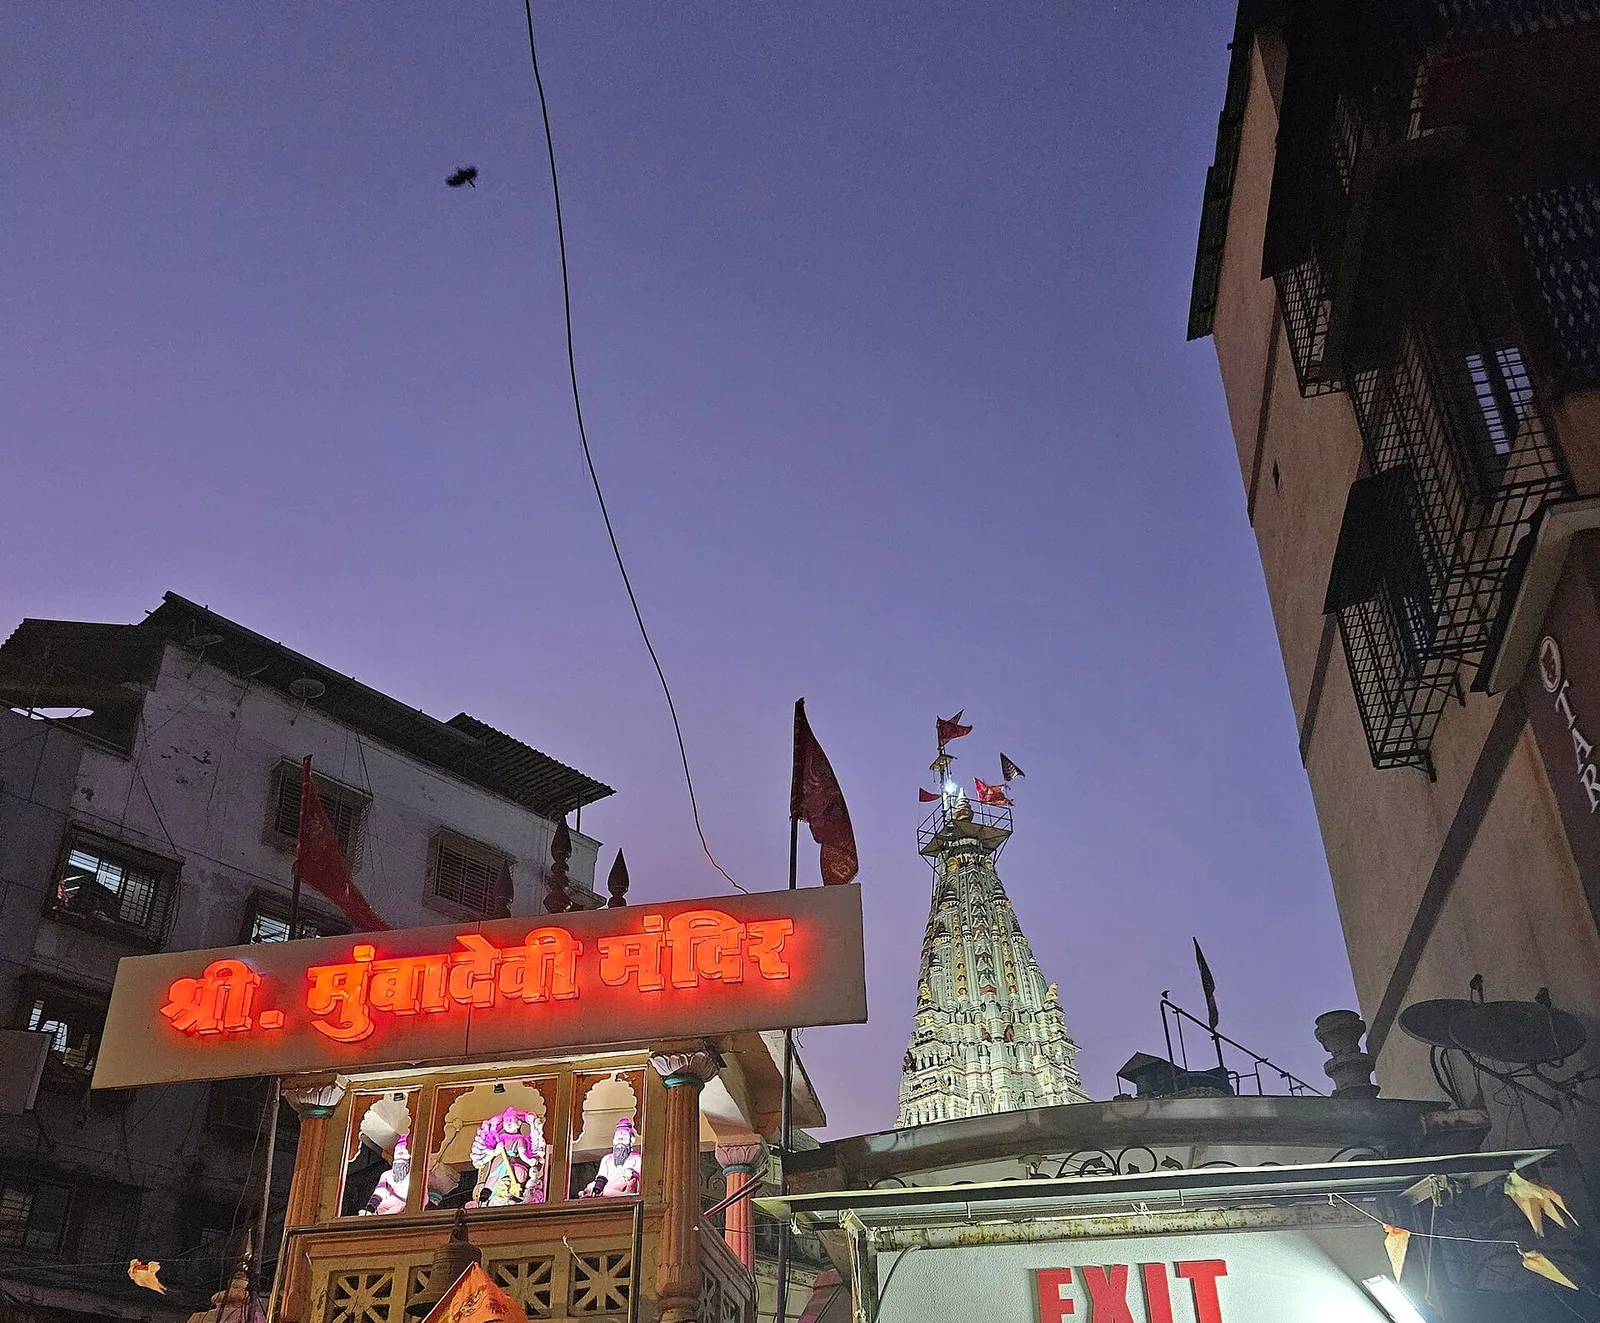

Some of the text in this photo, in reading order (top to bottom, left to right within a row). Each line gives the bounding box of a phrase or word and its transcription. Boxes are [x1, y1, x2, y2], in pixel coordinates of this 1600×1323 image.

[160, 909, 794, 1042] श्री. मुंबादेवी मंदिर
[1029, 1259, 1228, 1323] EXIT
